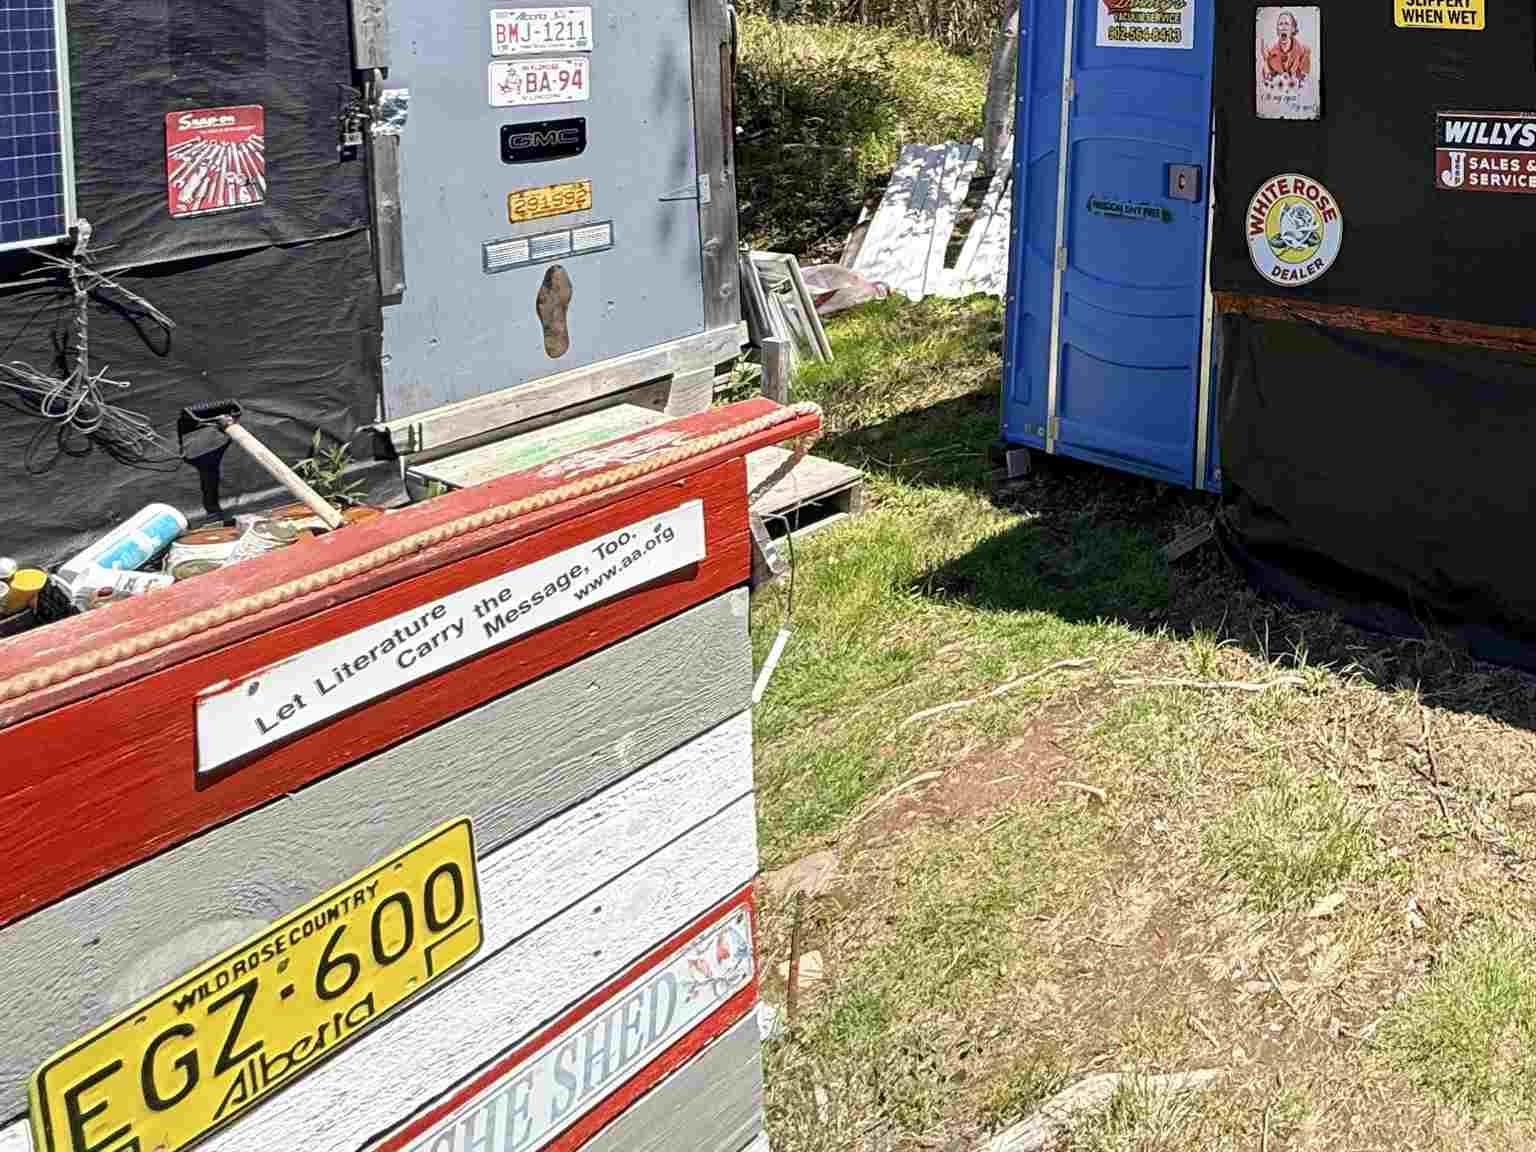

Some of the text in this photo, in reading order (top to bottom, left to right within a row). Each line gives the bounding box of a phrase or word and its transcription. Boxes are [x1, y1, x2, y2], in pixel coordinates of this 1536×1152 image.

[496, 20, 588, 44] BMJ-1211
[1401, 8, 1477, 25] WHEN WET
[508, 127, 580, 149] GMC
[1468, 157, 1536, 172] SALES &
[1249, 177, 1338, 236] WHITE ROSE
[1271, 257, 1325, 281] DEALER
[482, 530, 639, 639] Message, Too.
[572, 524, 677, 603] www.aa.org
[395, 584, 514, 671] Carry the
[254, 601, 449, 736] Let Literature
[172, 878, 381, 1017] WILD ROSE COUNTRY
[212, 991, 376, 1122] Alberta
[549, 970, 680, 1123] SHED
